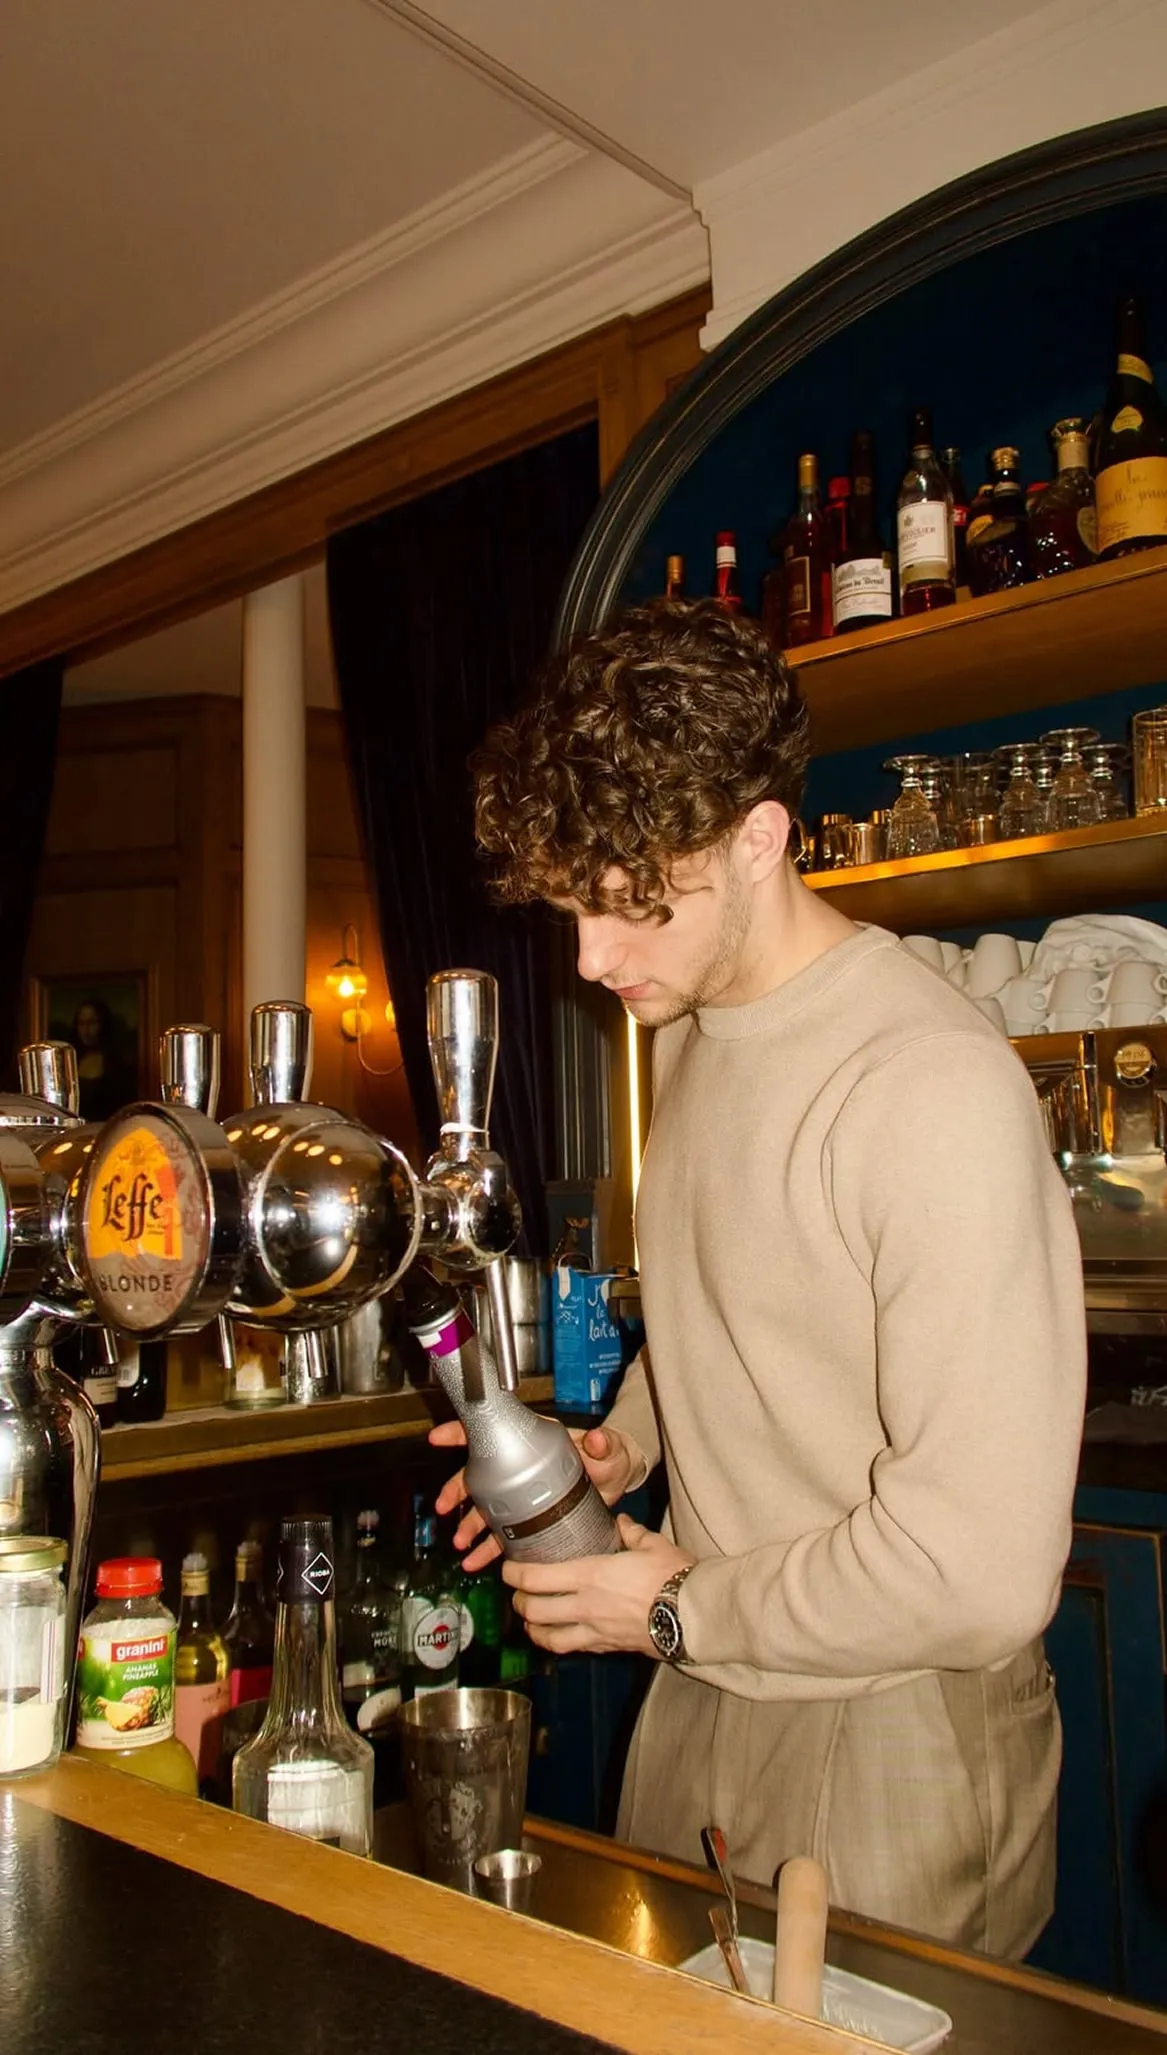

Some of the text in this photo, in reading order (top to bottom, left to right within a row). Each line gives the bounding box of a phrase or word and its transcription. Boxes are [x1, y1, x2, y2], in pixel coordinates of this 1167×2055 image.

[101, 1173, 163, 1242] Leffe
[100, 1274, 173, 1292] BLONDE
[116, 1639, 164, 1661] granini
